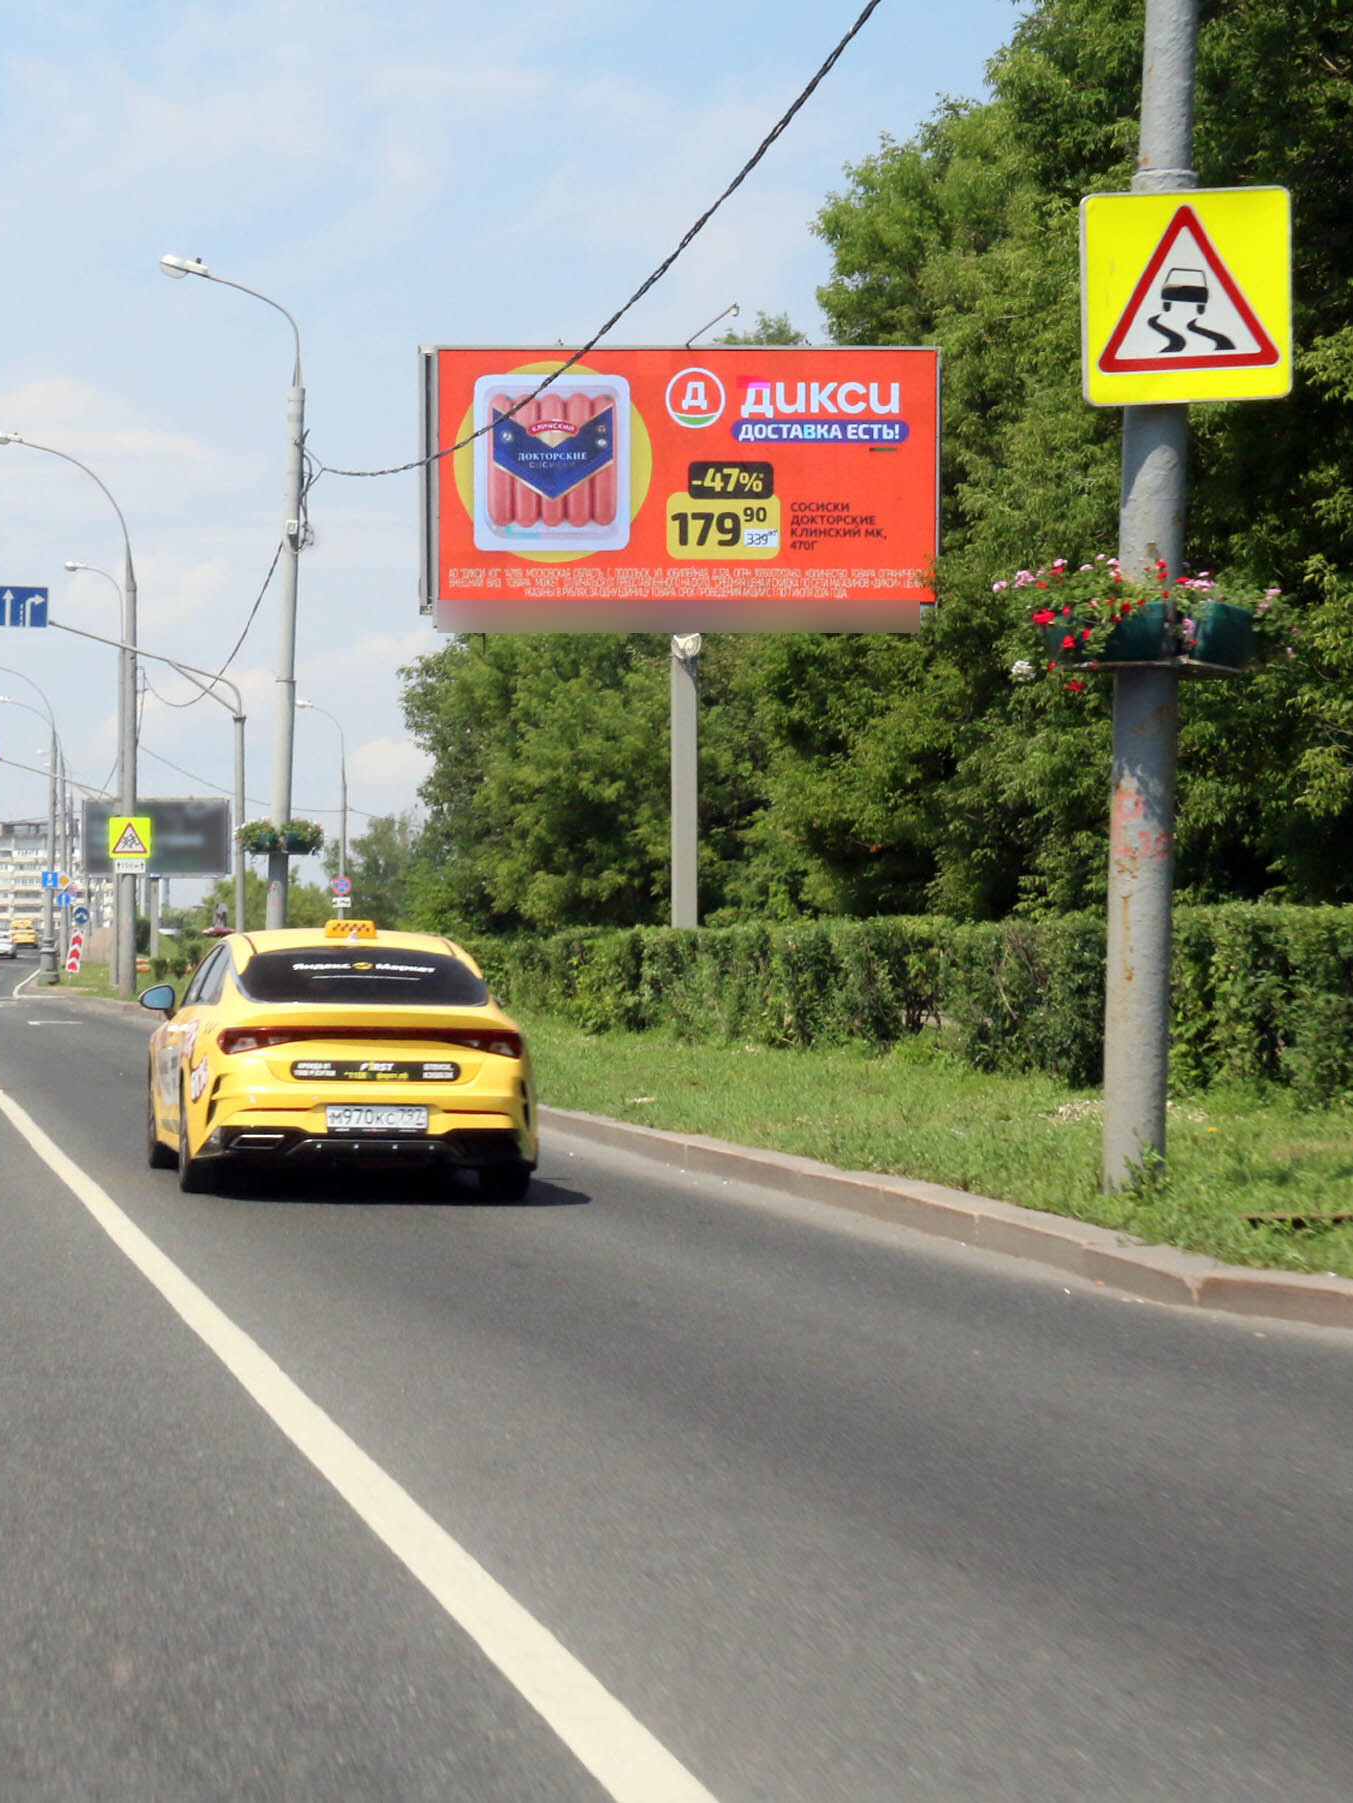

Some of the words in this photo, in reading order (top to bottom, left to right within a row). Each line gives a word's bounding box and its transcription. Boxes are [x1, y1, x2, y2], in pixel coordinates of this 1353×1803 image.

[739, 423, 843, 441] ДОСТАВКА
[847, 423, 900, 440] ЕСТЬ!
[518, 451, 587, 462] ДОКТОРСКИЕ
[790, 502, 850, 513] СОСИСКИ
[790, 515, 876, 526] ДОКТОРСКИЕ
[670, 511, 741, 546] 179
[743, 507, 767, 522] 90
[790, 527, 861, 538] КЛИНСКИЙ
[864, 528, 888, 540] МК,
[790, 540, 818, 551] 470Г
